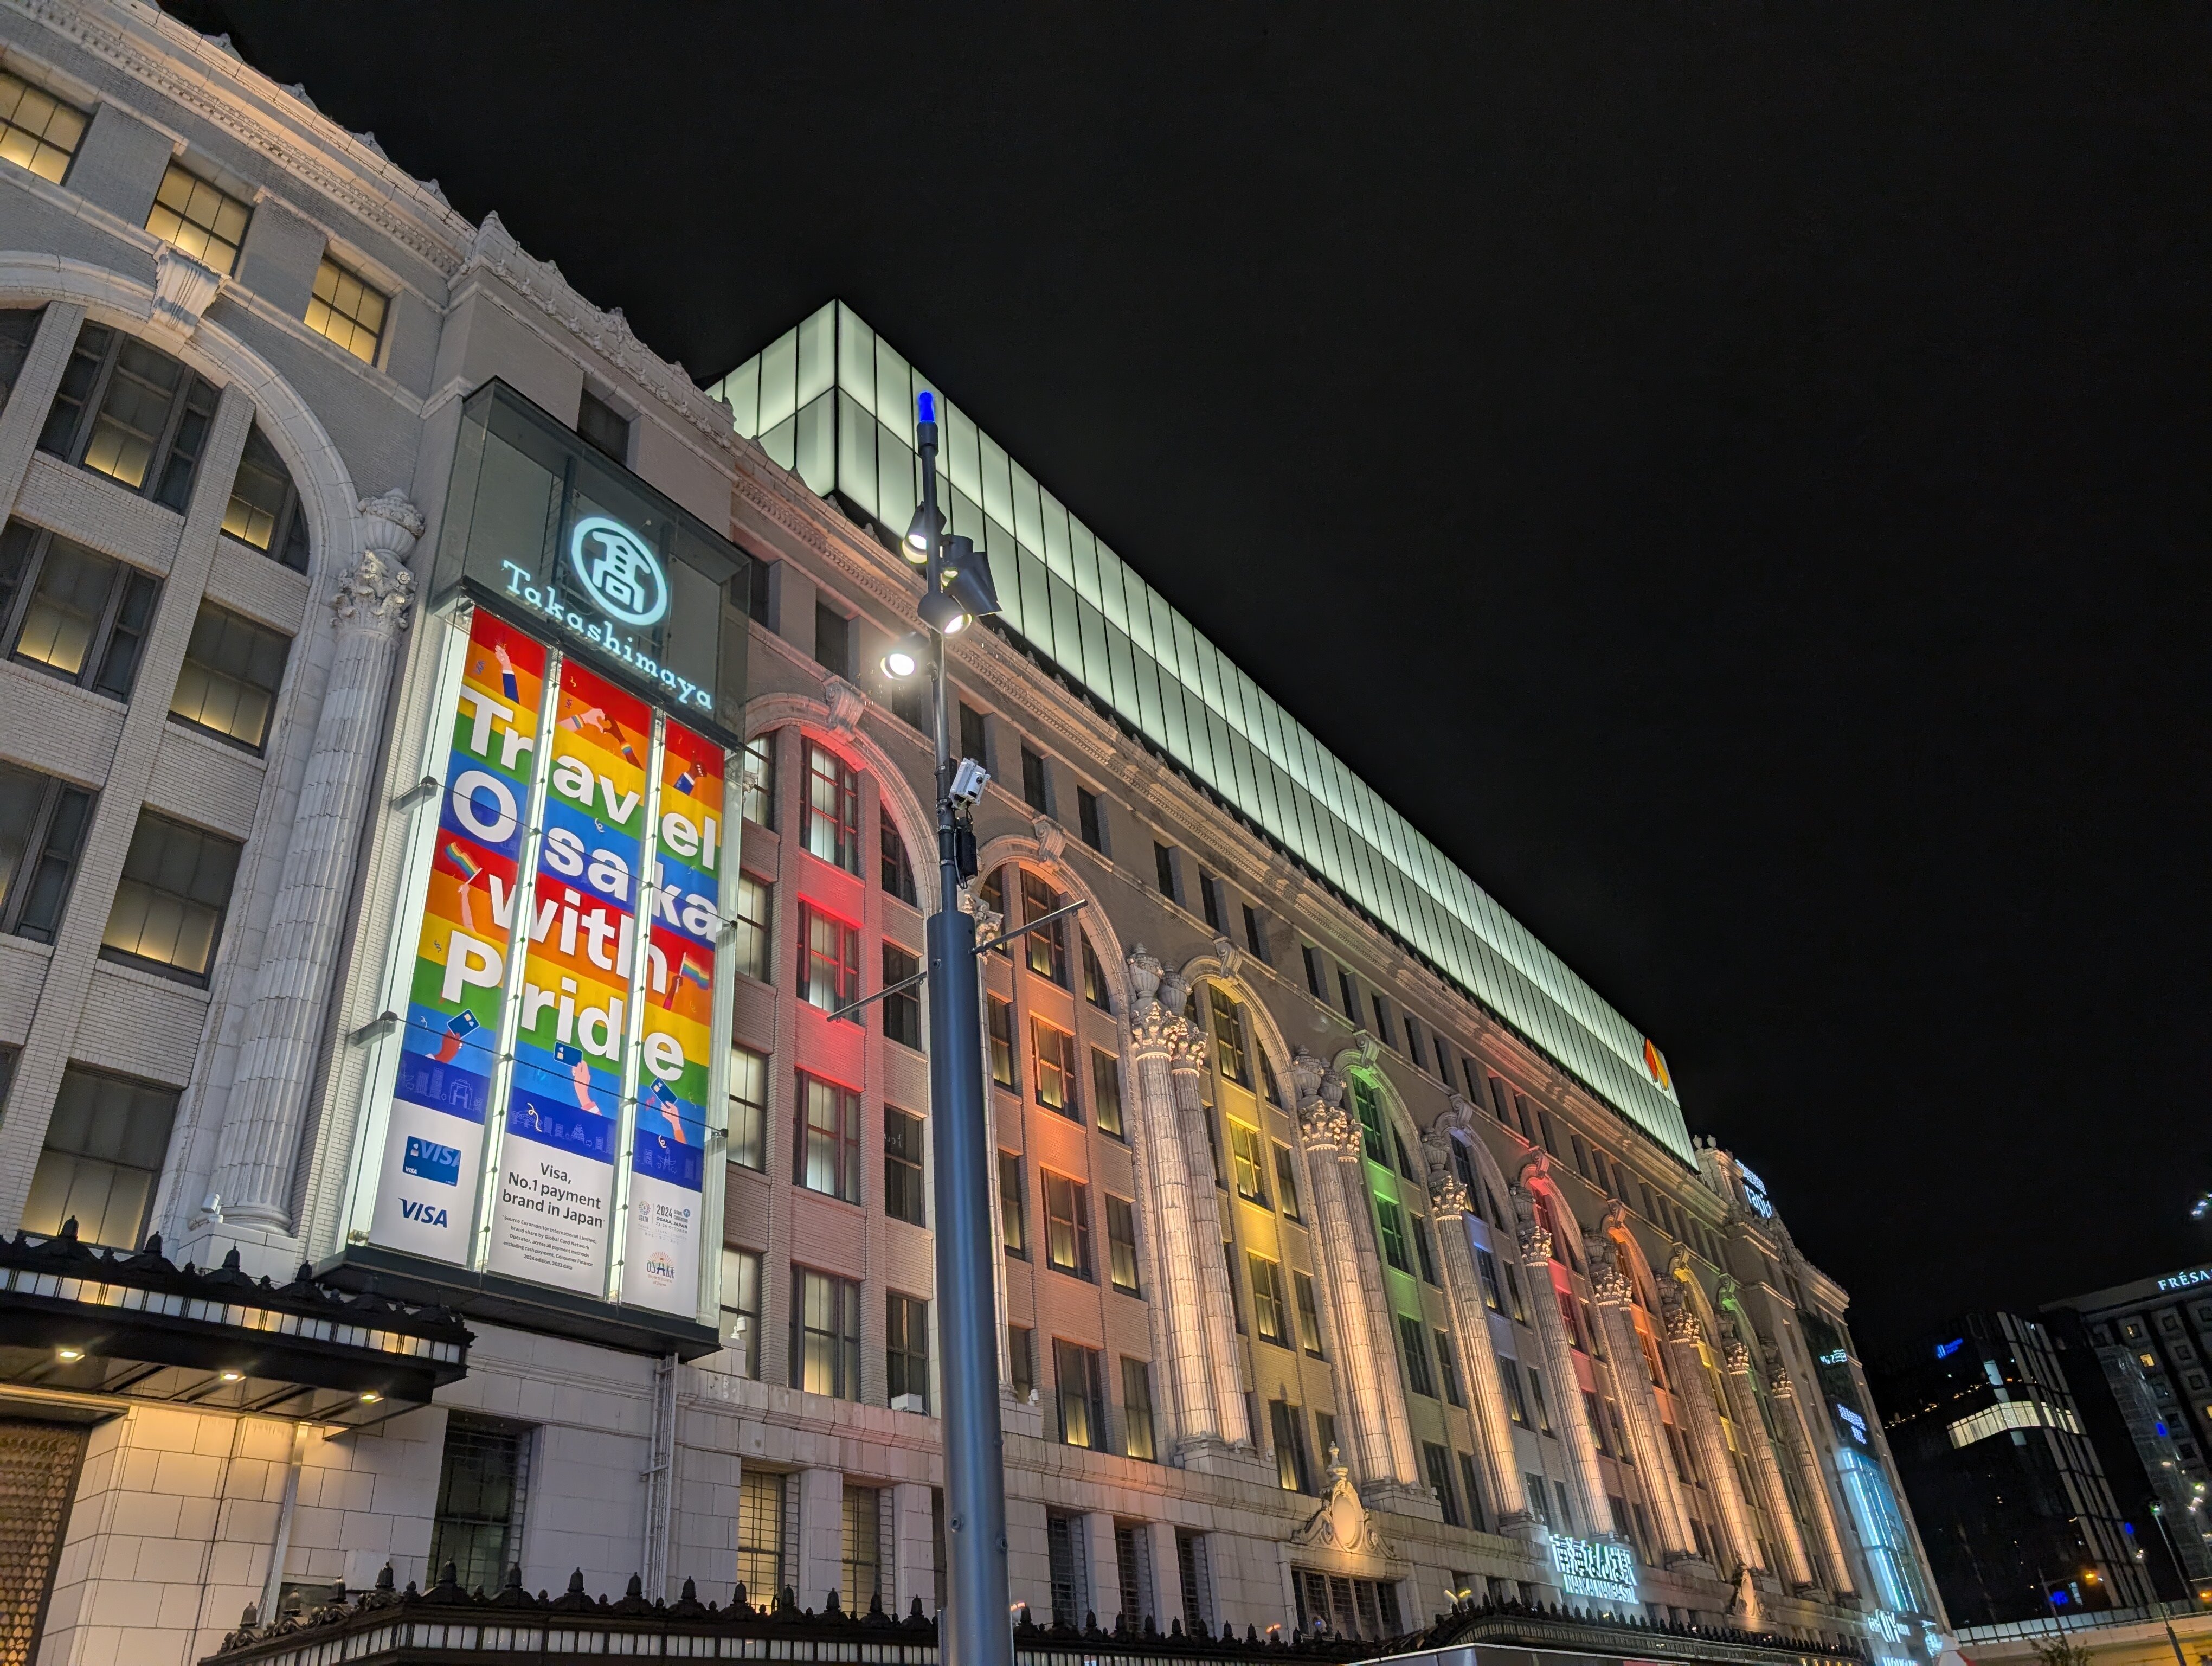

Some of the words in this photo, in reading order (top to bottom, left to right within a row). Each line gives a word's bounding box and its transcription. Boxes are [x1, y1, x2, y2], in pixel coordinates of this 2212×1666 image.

[502, 560, 713, 710] Takashimaya
[460, 684, 716, 870] Travel
[452, 770, 718, 944] Osaka
[489, 874, 667, 994] with
[442, 930, 685, 1081] Pride
[405, 1166, 417, 1175] VISA
[540, 1162, 571, 1184] Visa,
[503, 1188, 544, 1213] brand
[548, 1201, 560, 1217] in
[508, 1171, 538, 1191] No.1
[541, 1183, 601, 1209] payment
[397, 1197, 448, 1228] VISA
[656, 1216, 673, 1225] OSAKA,
[657, 1204, 673, 1219] 2024
[521, 1220, 550, 1231] Euromonitor
[550, 1228, 578, 1239] International
[668, 1225, 687, 1234] OCTOBER
[503, 1241, 524, 1251] excluding
[555, 1254, 576, 1263] Consumer
[577, 1259, 593, 1267] Finance
[509, 1233, 531, 1244] Operator,
[552, 1245, 570, 1253] payment
[570, 1250, 589, 1258] methods
[570, 1241, 590, 1250] Network
[1549, 1534, 1638, 1586] 南海なんば駅
